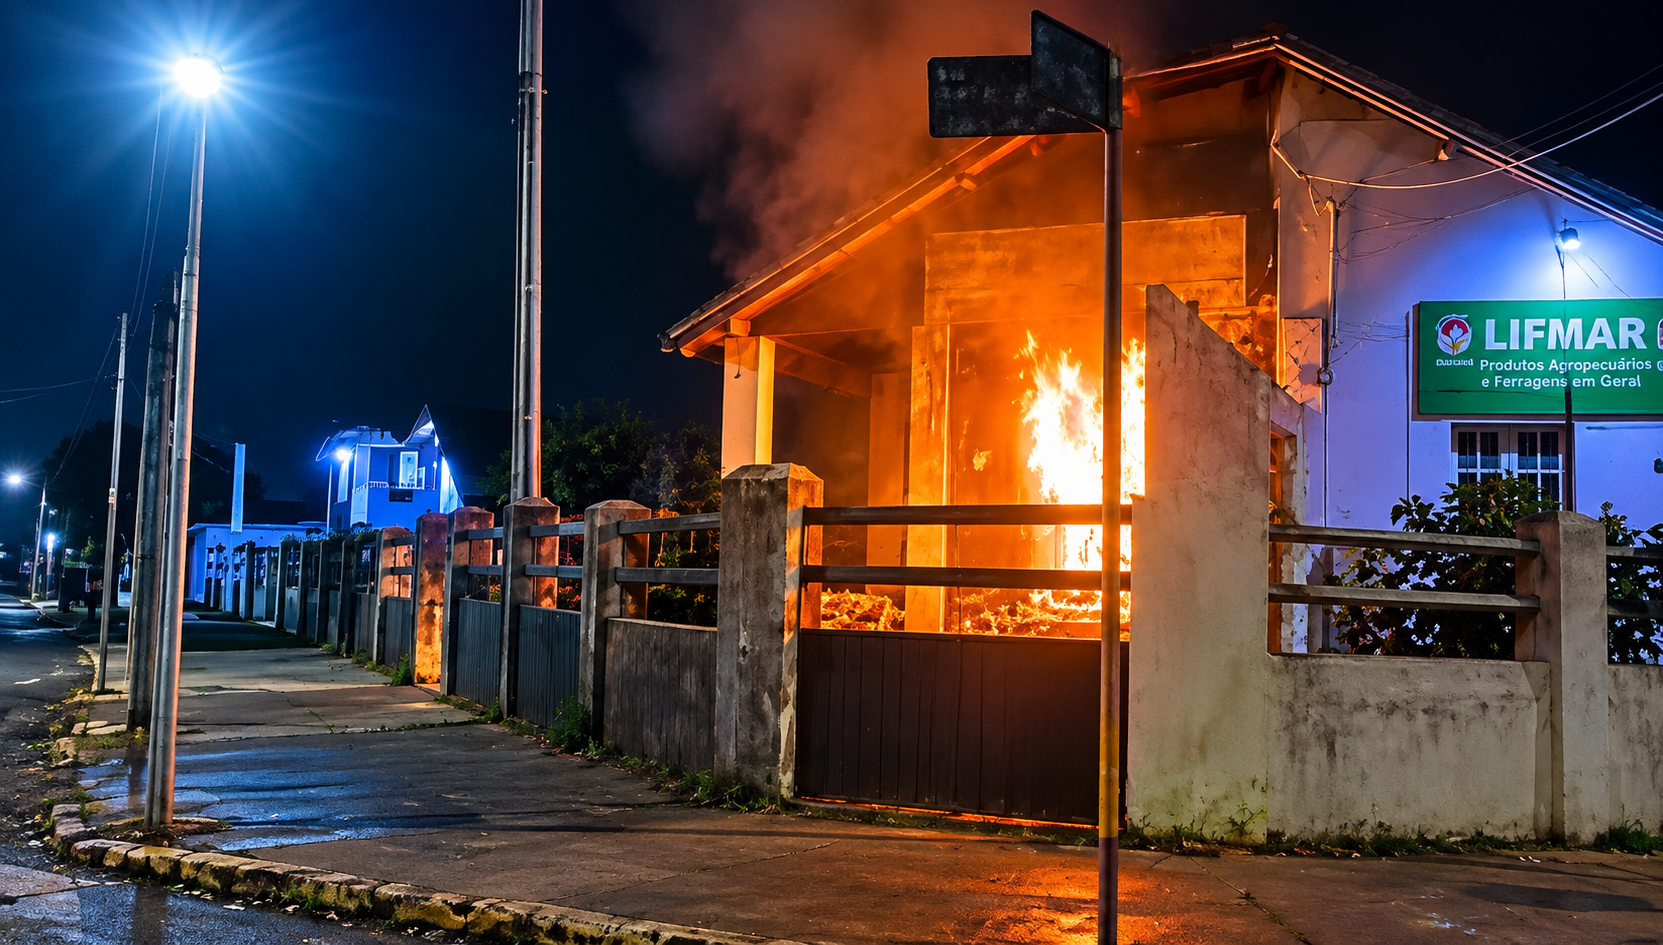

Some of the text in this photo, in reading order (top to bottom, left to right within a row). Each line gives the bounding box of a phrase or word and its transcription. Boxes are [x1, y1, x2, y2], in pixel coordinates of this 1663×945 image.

[1485, 317, 1647, 350] LIFMAR
[1480, 359, 1544, 371] Produtos
[1549, 358, 1652, 373] Agropecuários
[1481, 374, 1641, 389] e Ferragens em Geral
